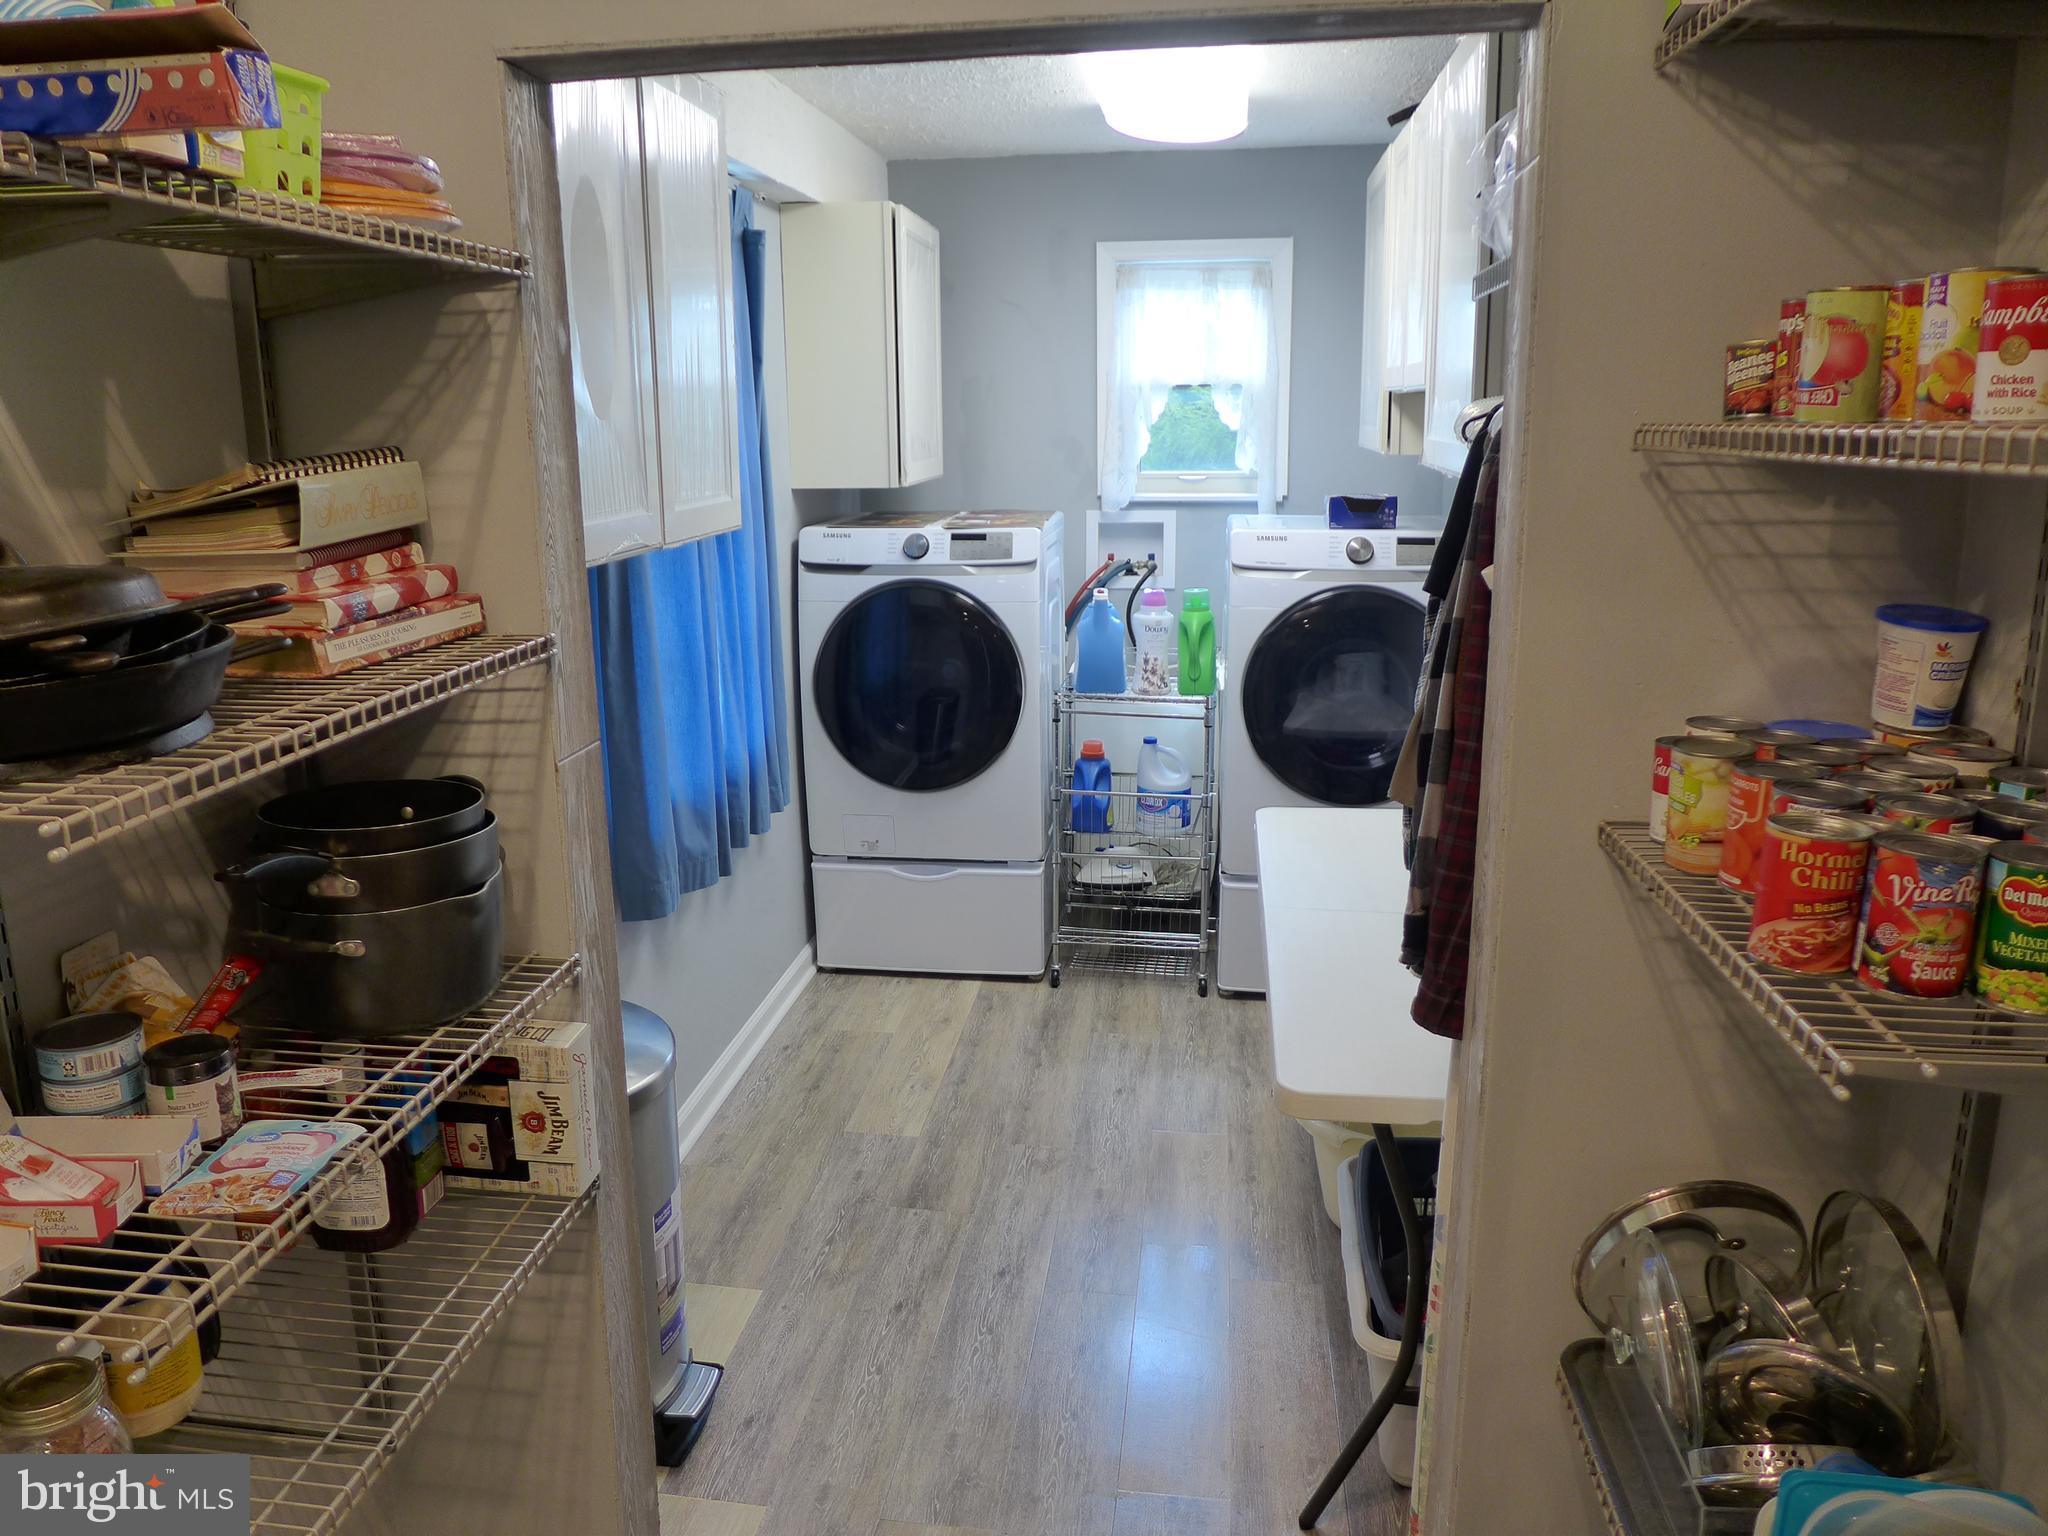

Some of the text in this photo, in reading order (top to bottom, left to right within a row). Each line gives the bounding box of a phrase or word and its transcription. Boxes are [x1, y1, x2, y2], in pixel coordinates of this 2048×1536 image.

[1990, 374, 2034, 386] Chicken
[1987, 387, 2038, 398] with Rice
[1991, 406, 2024, 416] SOUP
[1144, 624, 1169, 634] Downy
[1790, 866, 1854, 890] Chili
[1888, 873, 1954, 906] Vine
[2003, 886, 2026, 904] Del
[1793, 900, 1849, 913] No Beans
[1910, 961, 1957, 981] Sauce
[537, 1090, 569, 1156] JIM BEAM
